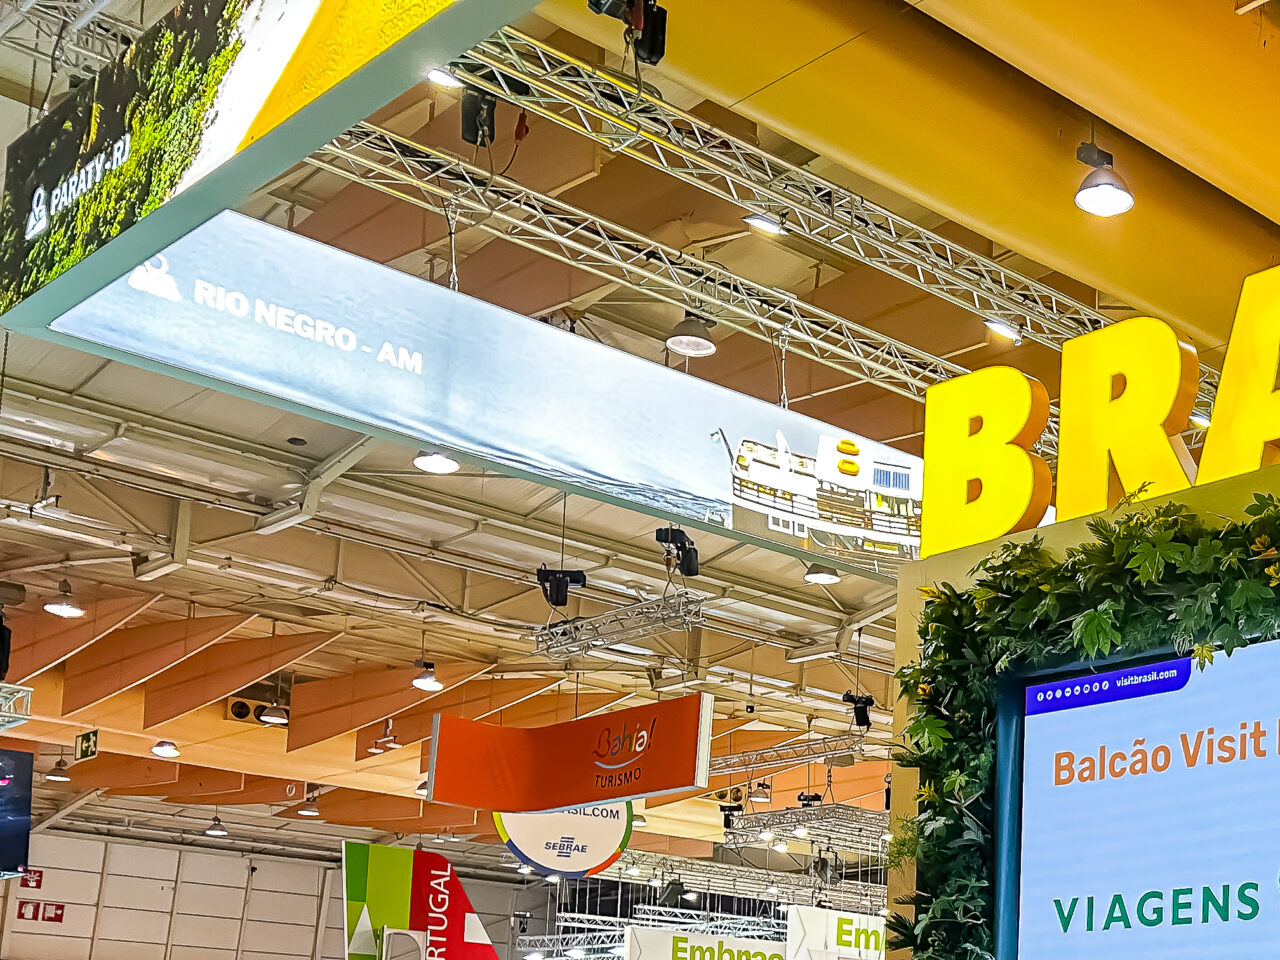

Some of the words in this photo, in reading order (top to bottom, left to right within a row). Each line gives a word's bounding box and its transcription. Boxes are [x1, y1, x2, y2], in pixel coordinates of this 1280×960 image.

[50, 151, 105, 216] PARATY
[194, 277, 249, 319] RIO
[255, 302, 357, 355] NEGRO
[377, 340, 425, 376] AM
[1116, 669, 1178, 688] visitbrasil.com
[592, 716, 657, 758] Bahia!
[1053, 737, 1172, 787] Balcão
[1179, 721, 1268, 769] Visit
[594, 767, 641, 789] TURISMO
[544, 841, 588, 853] SEBRAE
[1053, 882, 1261, 934] VIAGENS
